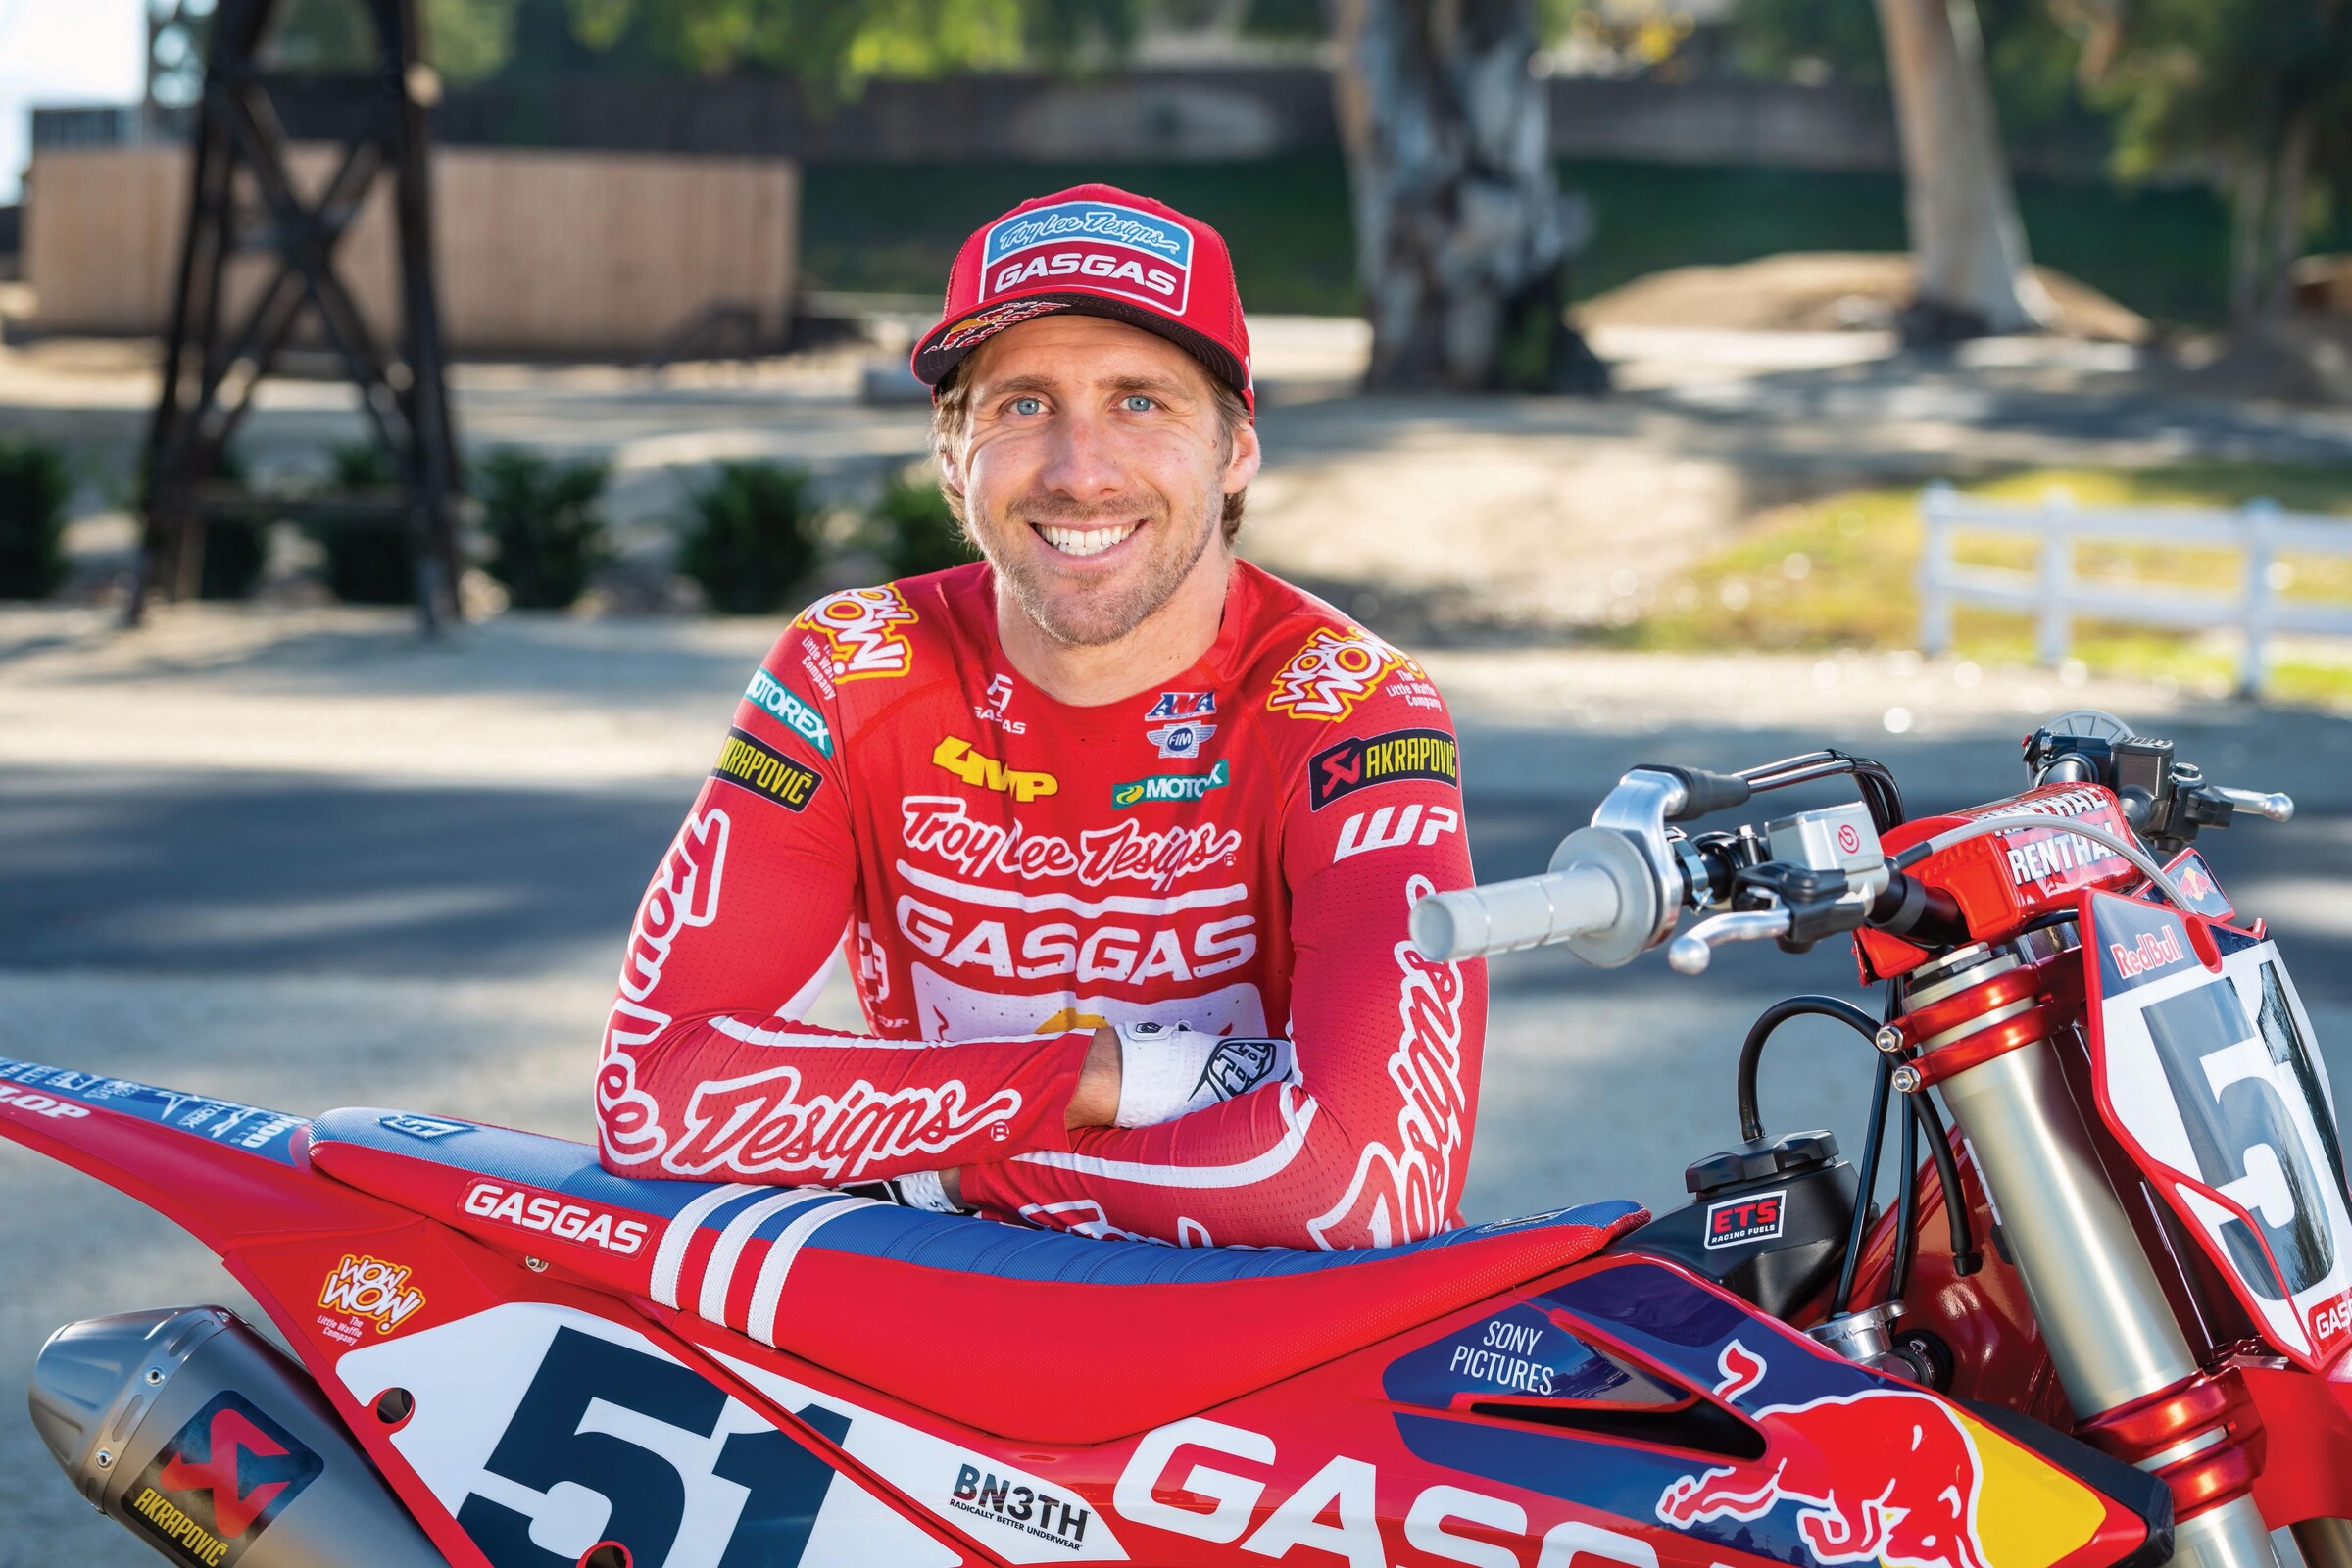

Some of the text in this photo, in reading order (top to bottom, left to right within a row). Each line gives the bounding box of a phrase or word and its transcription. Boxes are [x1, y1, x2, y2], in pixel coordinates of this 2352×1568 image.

[1000, 211, 1180, 253] Troy Lee Designs
[994, 252, 1177, 295] GASGAS
[802, 655, 836, 700] Company
[1168, 732, 1193, 747] FIM
[1146, 762, 1223, 799] MOTOX
[901, 796, 1005, 878] Troy
[1077, 817, 1242, 891] Designs
[1333, 804, 1458, 864] WP
[896, 894, 1257, 986] GASGAS
[662, 1066, 1022, 1179] Designs
[465, 1183, 648, 1254] GASGAS
[1711, 1224, 1776, 1244] RACING FUELS
[1714, 1200, 1778, 1234] ETS
[339, 1257, 407, 1291] WOW
[317, 1314, 363, 1338] Little Waffle
[322, 1326, 359, 1347] Company
[349, 1315, 365, 1328] The
[1483, 1320, 1544, 1356] SONY
[1449, 1345, 1555, 1396] PICTURES
[456, 1325, 853, 1568] 51
[949, 1497, 1081, 1551] RADICALLY BETTER UNDERWEAR
[953, 1463, 1089, 1542] BN3TH
